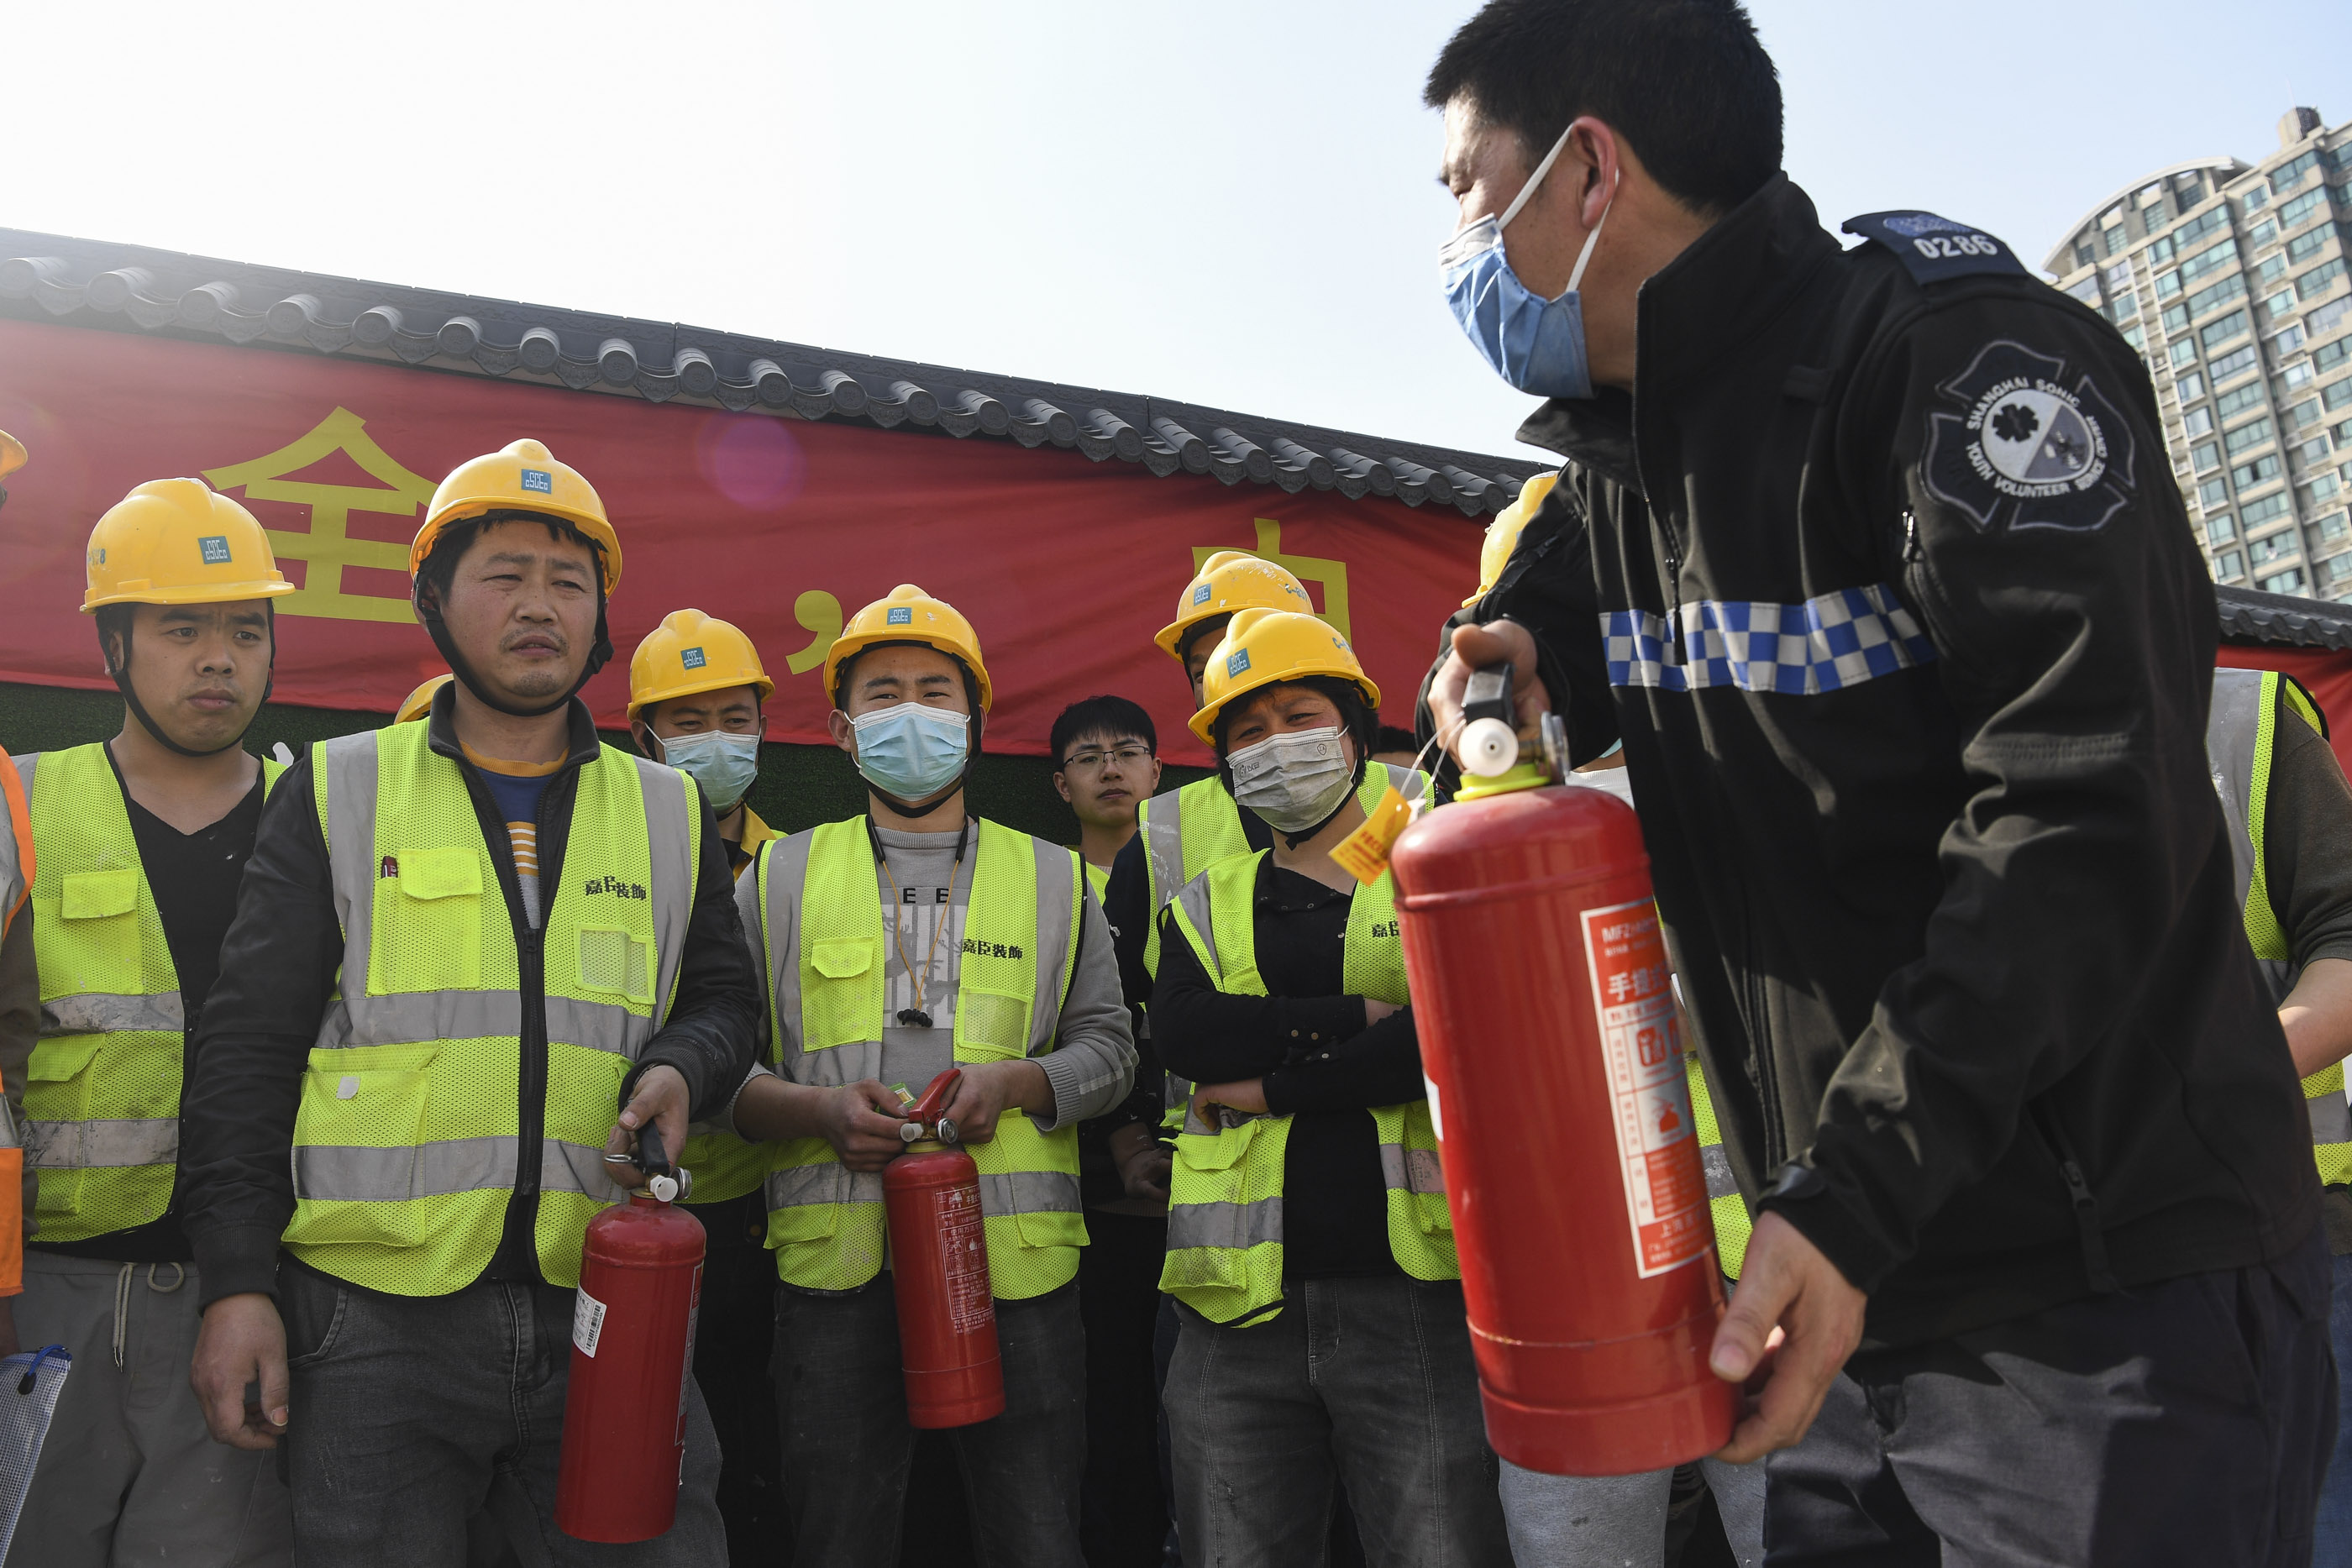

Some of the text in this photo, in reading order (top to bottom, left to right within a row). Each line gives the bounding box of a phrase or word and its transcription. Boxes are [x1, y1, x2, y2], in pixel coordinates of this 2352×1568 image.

[1913, 234, 1998, 260] 0286
[1966, 375, 2081, 431] SHANGHAI SONIC
[1966, 441, 1996, 481] YOUTH
[1993, 475, 2071, 498] VOLUNTEER
